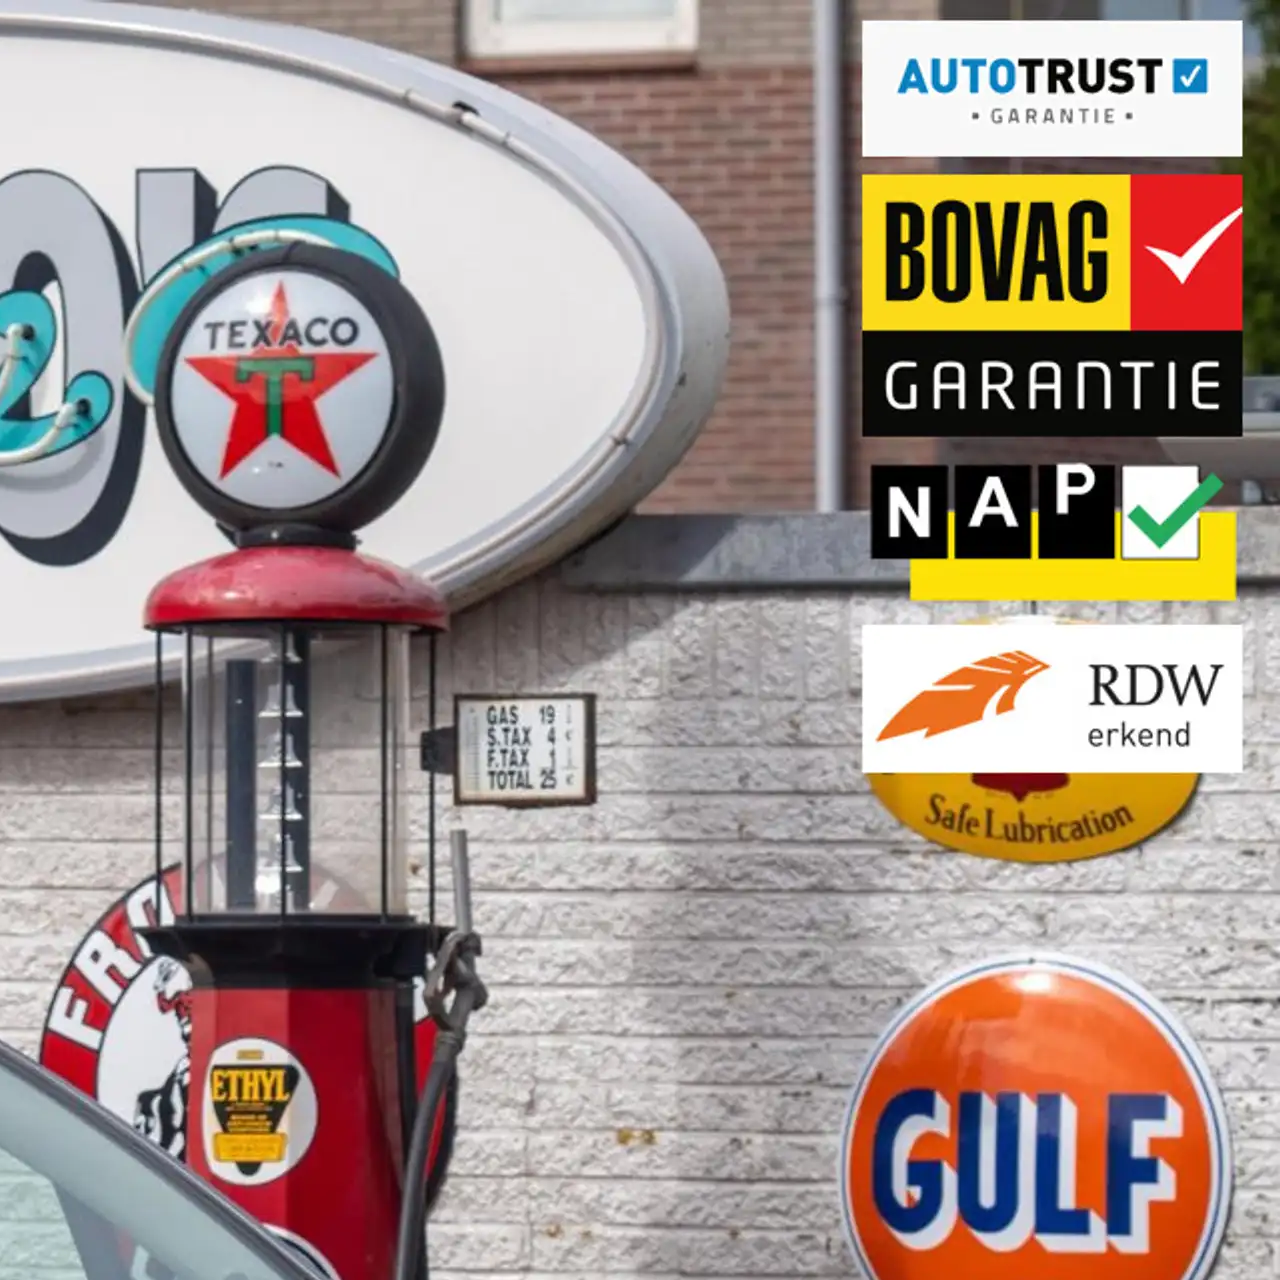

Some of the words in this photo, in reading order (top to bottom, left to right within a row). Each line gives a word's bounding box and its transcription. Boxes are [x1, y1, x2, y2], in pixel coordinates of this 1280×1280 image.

[204, 317, 359, 350] TEXACO
[487, 704, 519, 724] GAS
[540, 704, 556, 724] 19
[487, 727, 532, 746] S.TAX
[547, 726, 556, 743] 4
[487, 748, 530, 768] F.TAX
[487, 770, 534, 790] TOTAL
[540, 770, 557, 790] 25
[924, 794, 980, 837] Safe
[985, 805, 1135, 844] Lubrication
[212, 1069, 290, 1102] ETHYL
[871, 1088, 1184, 1254] GULF
